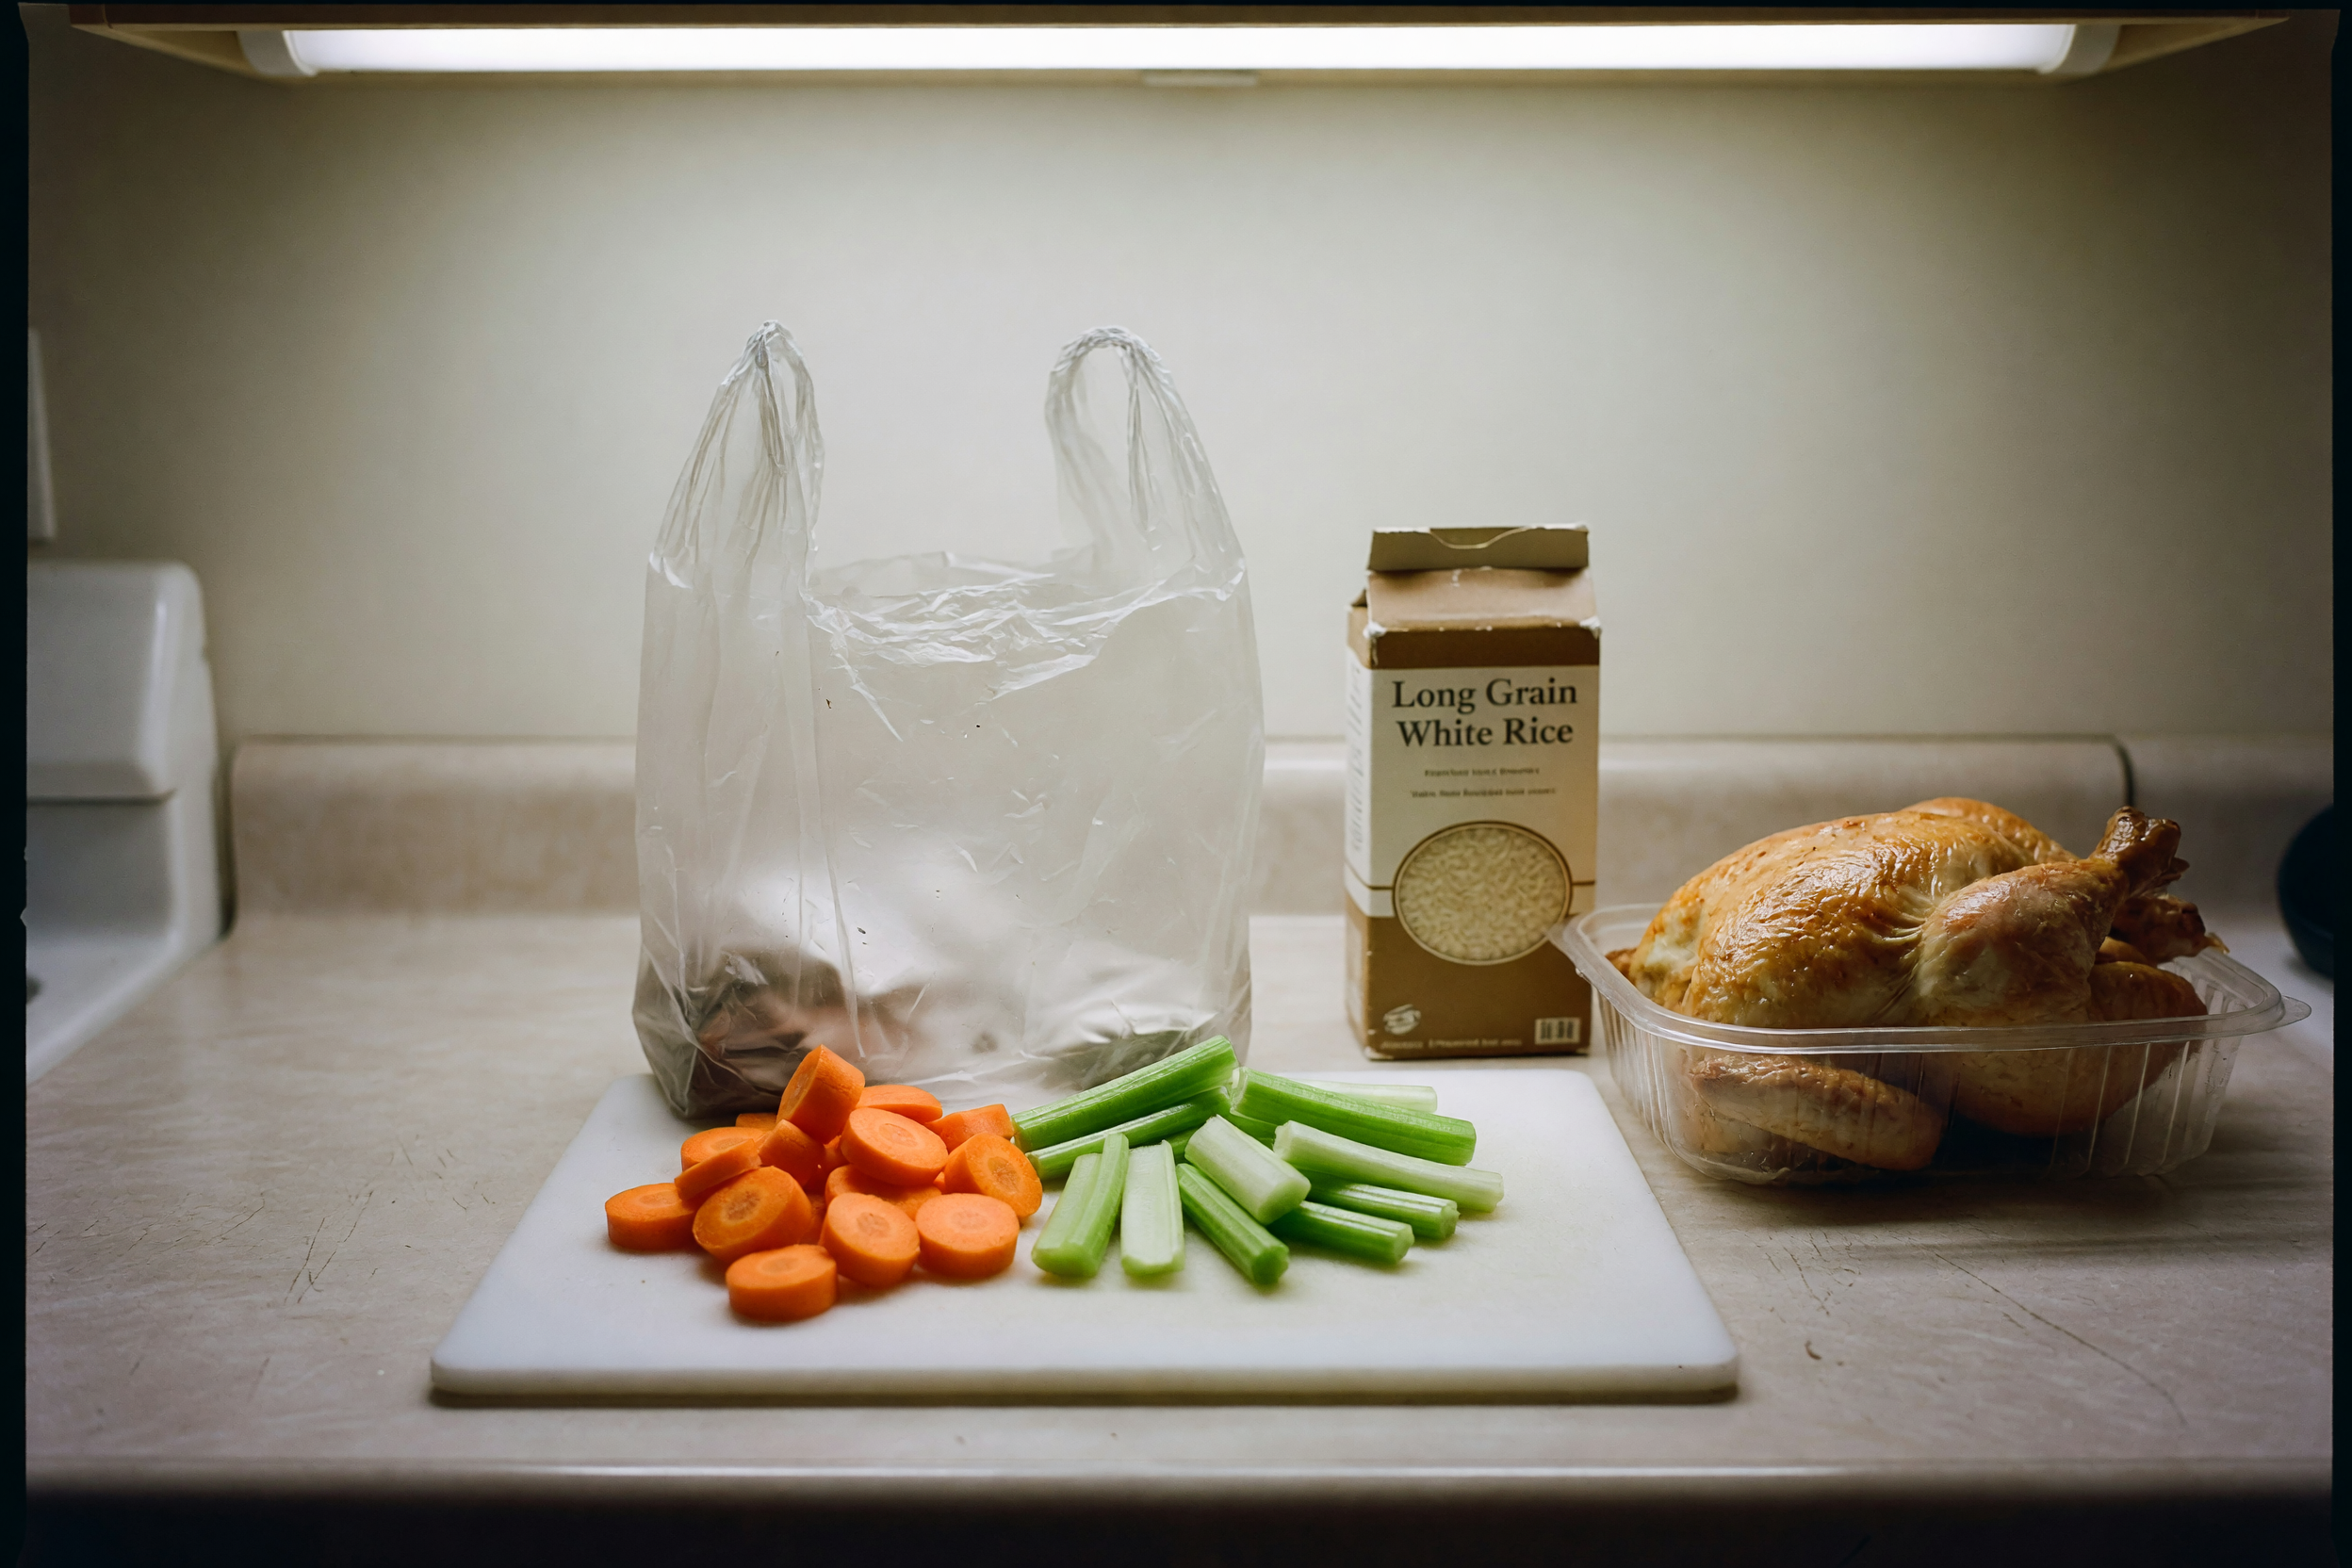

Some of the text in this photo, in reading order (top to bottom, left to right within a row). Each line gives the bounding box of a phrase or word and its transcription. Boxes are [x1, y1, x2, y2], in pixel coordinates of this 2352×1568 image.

[1392, 677, 1577, 715] Long Grain
[1396, 716, 1573, 747] White Rice
